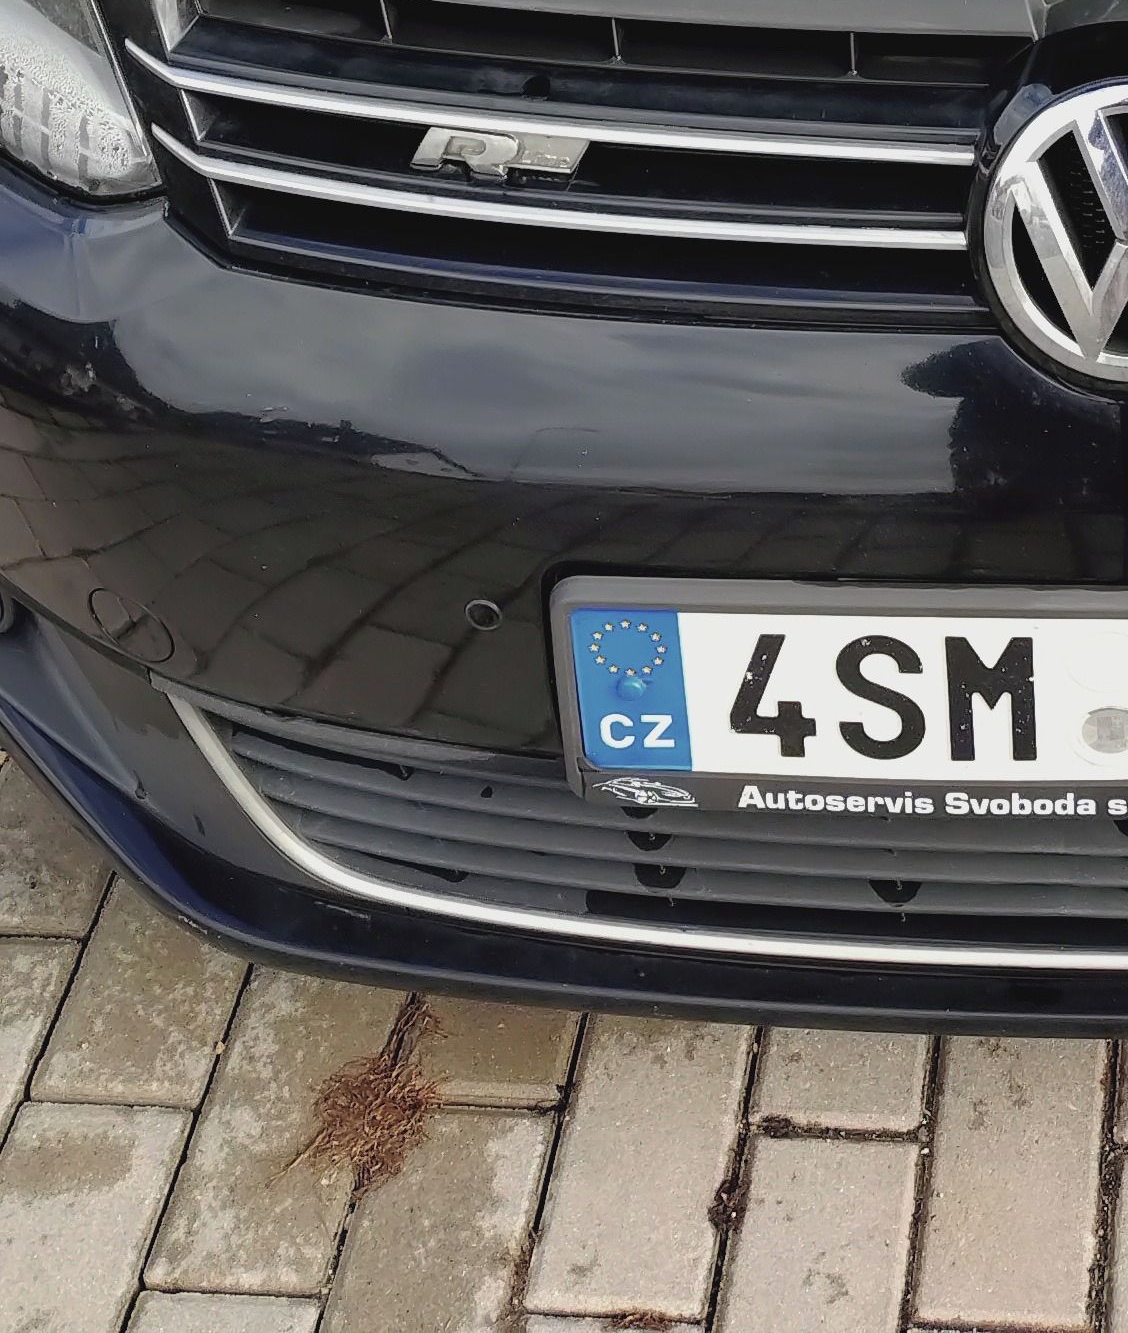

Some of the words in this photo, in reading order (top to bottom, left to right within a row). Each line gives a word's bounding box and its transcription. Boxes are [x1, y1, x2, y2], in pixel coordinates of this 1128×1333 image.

[729, 633, 1038, 762] 4SM
[599, 713, 676, 750] CZ
[737, 784, 935, 816] Autoservis
[944, 791, 1097, 816] Svoboda
